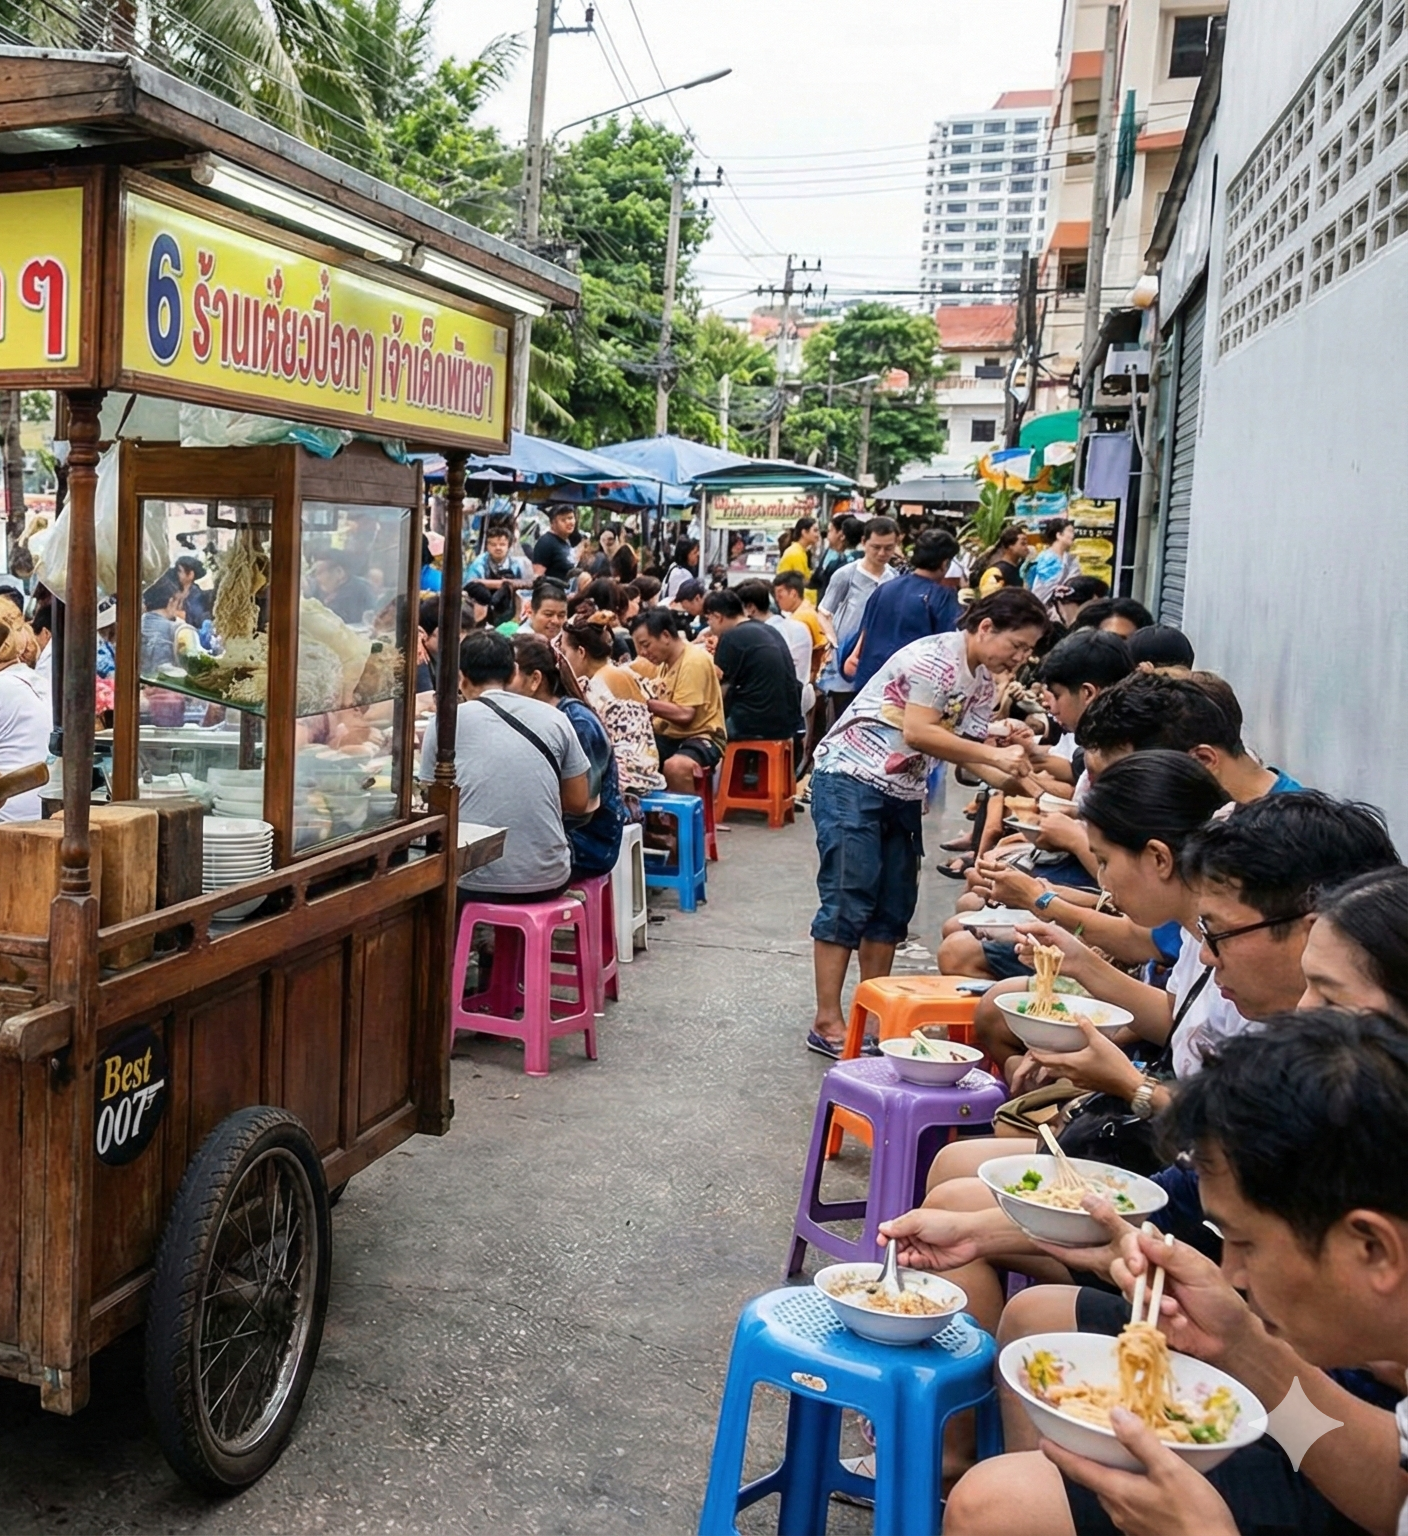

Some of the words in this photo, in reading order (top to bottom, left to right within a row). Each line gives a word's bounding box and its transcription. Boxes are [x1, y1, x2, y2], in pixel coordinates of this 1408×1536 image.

[147, 233, 182, 363] 6
[100, 1046, 153, 1102] Best
[96, 1078, 165, 1156] 007
